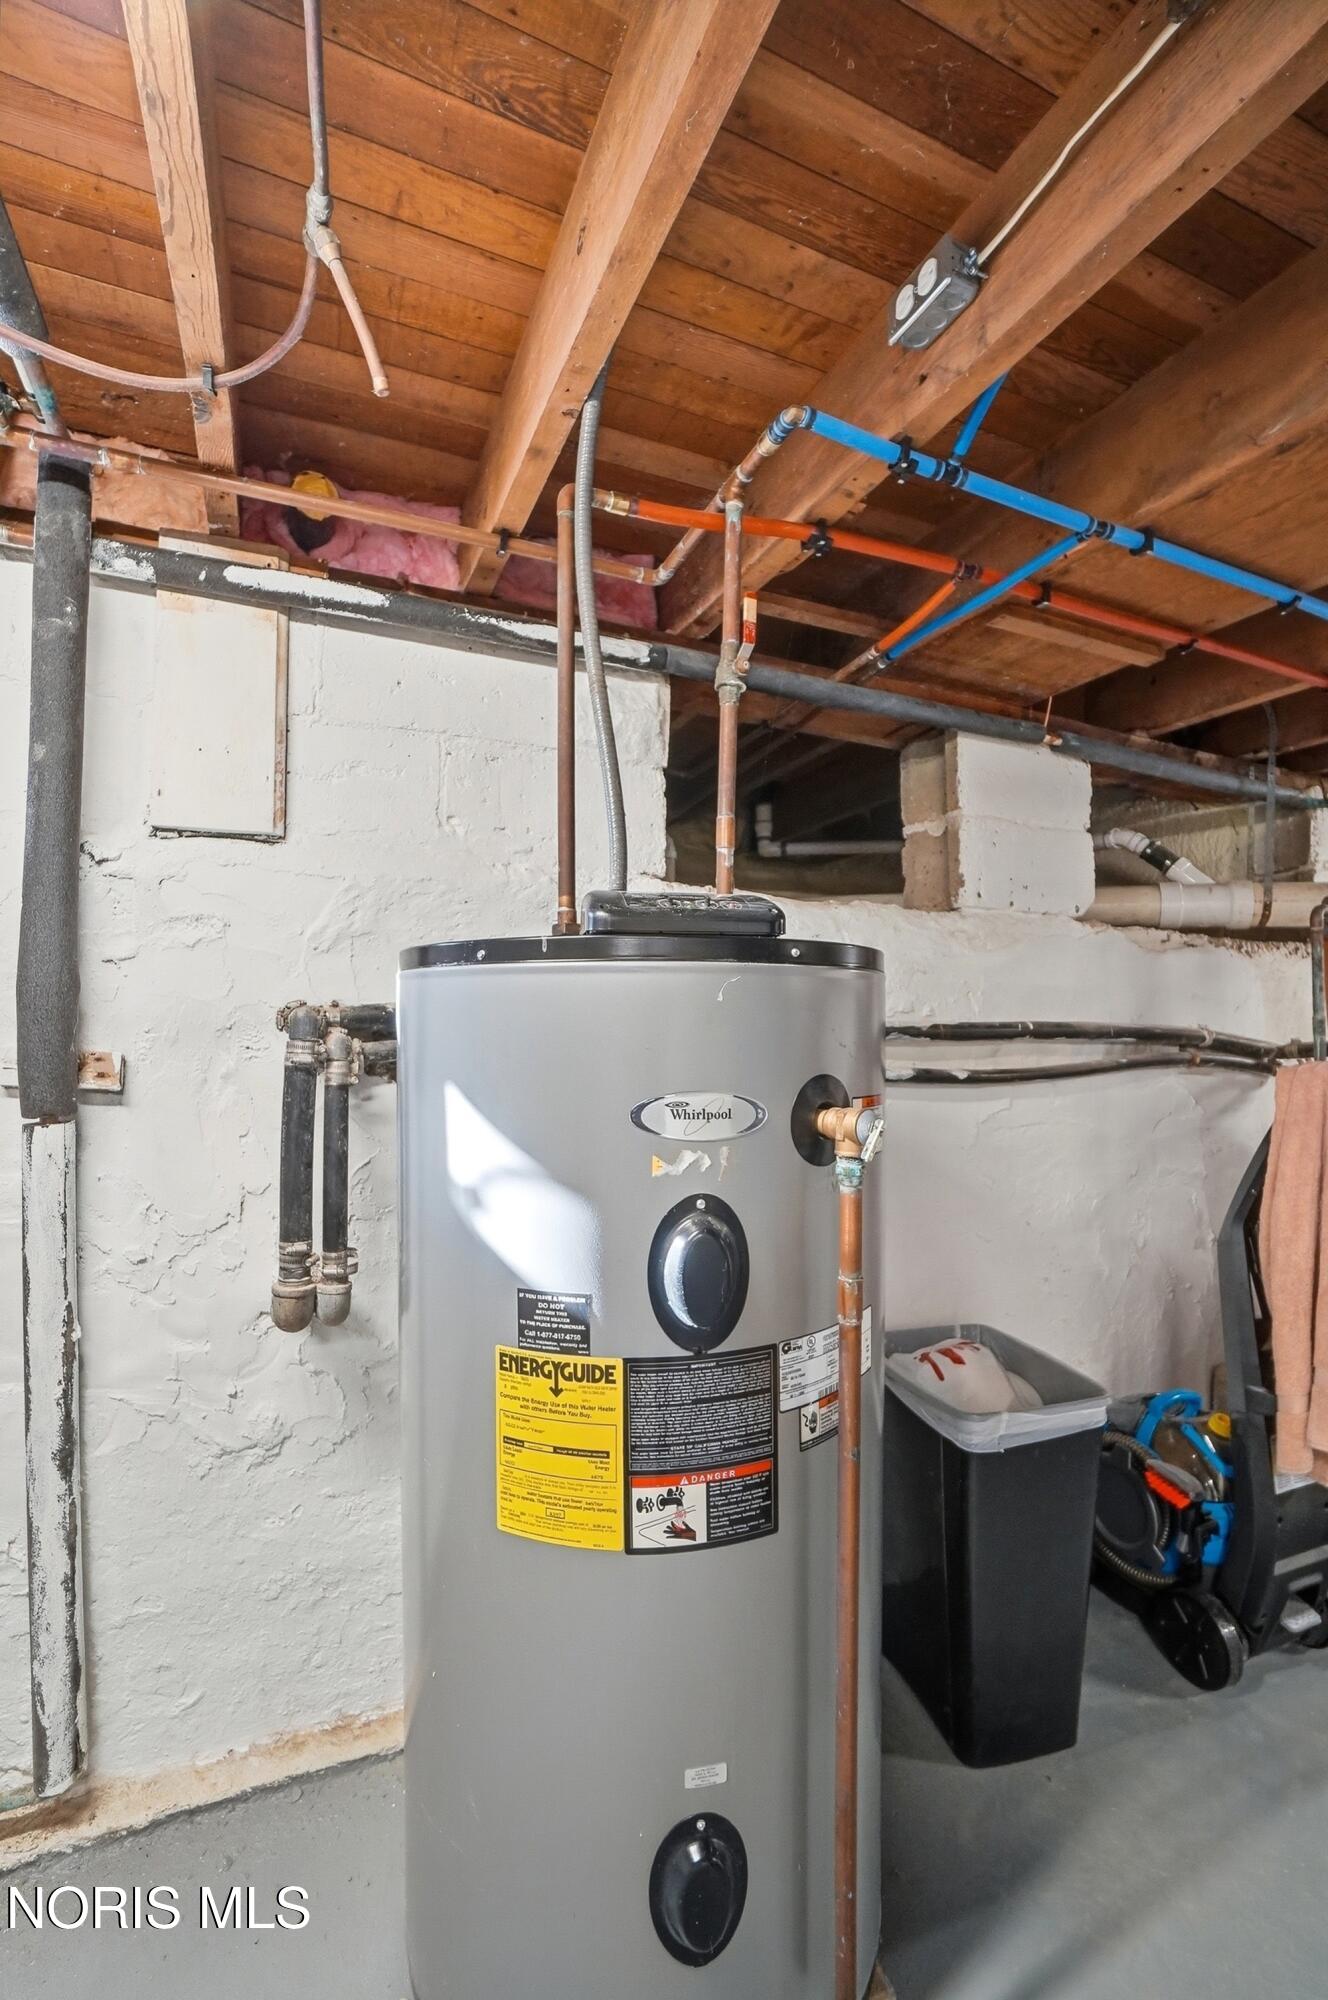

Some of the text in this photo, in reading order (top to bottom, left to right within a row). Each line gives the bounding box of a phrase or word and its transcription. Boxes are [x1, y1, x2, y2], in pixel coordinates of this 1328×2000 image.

[670, 1108, 732, 1123] Whirlpool
[499, 1352, 616, 1385] ENERGYGUIDE
[500, 1392, 520, 1401] Compare
[531, 1398, 548, 1407] Energy
[579, 1411, 592, 1419] Buy.
[691, 1470, 736, 1483] DANGER
